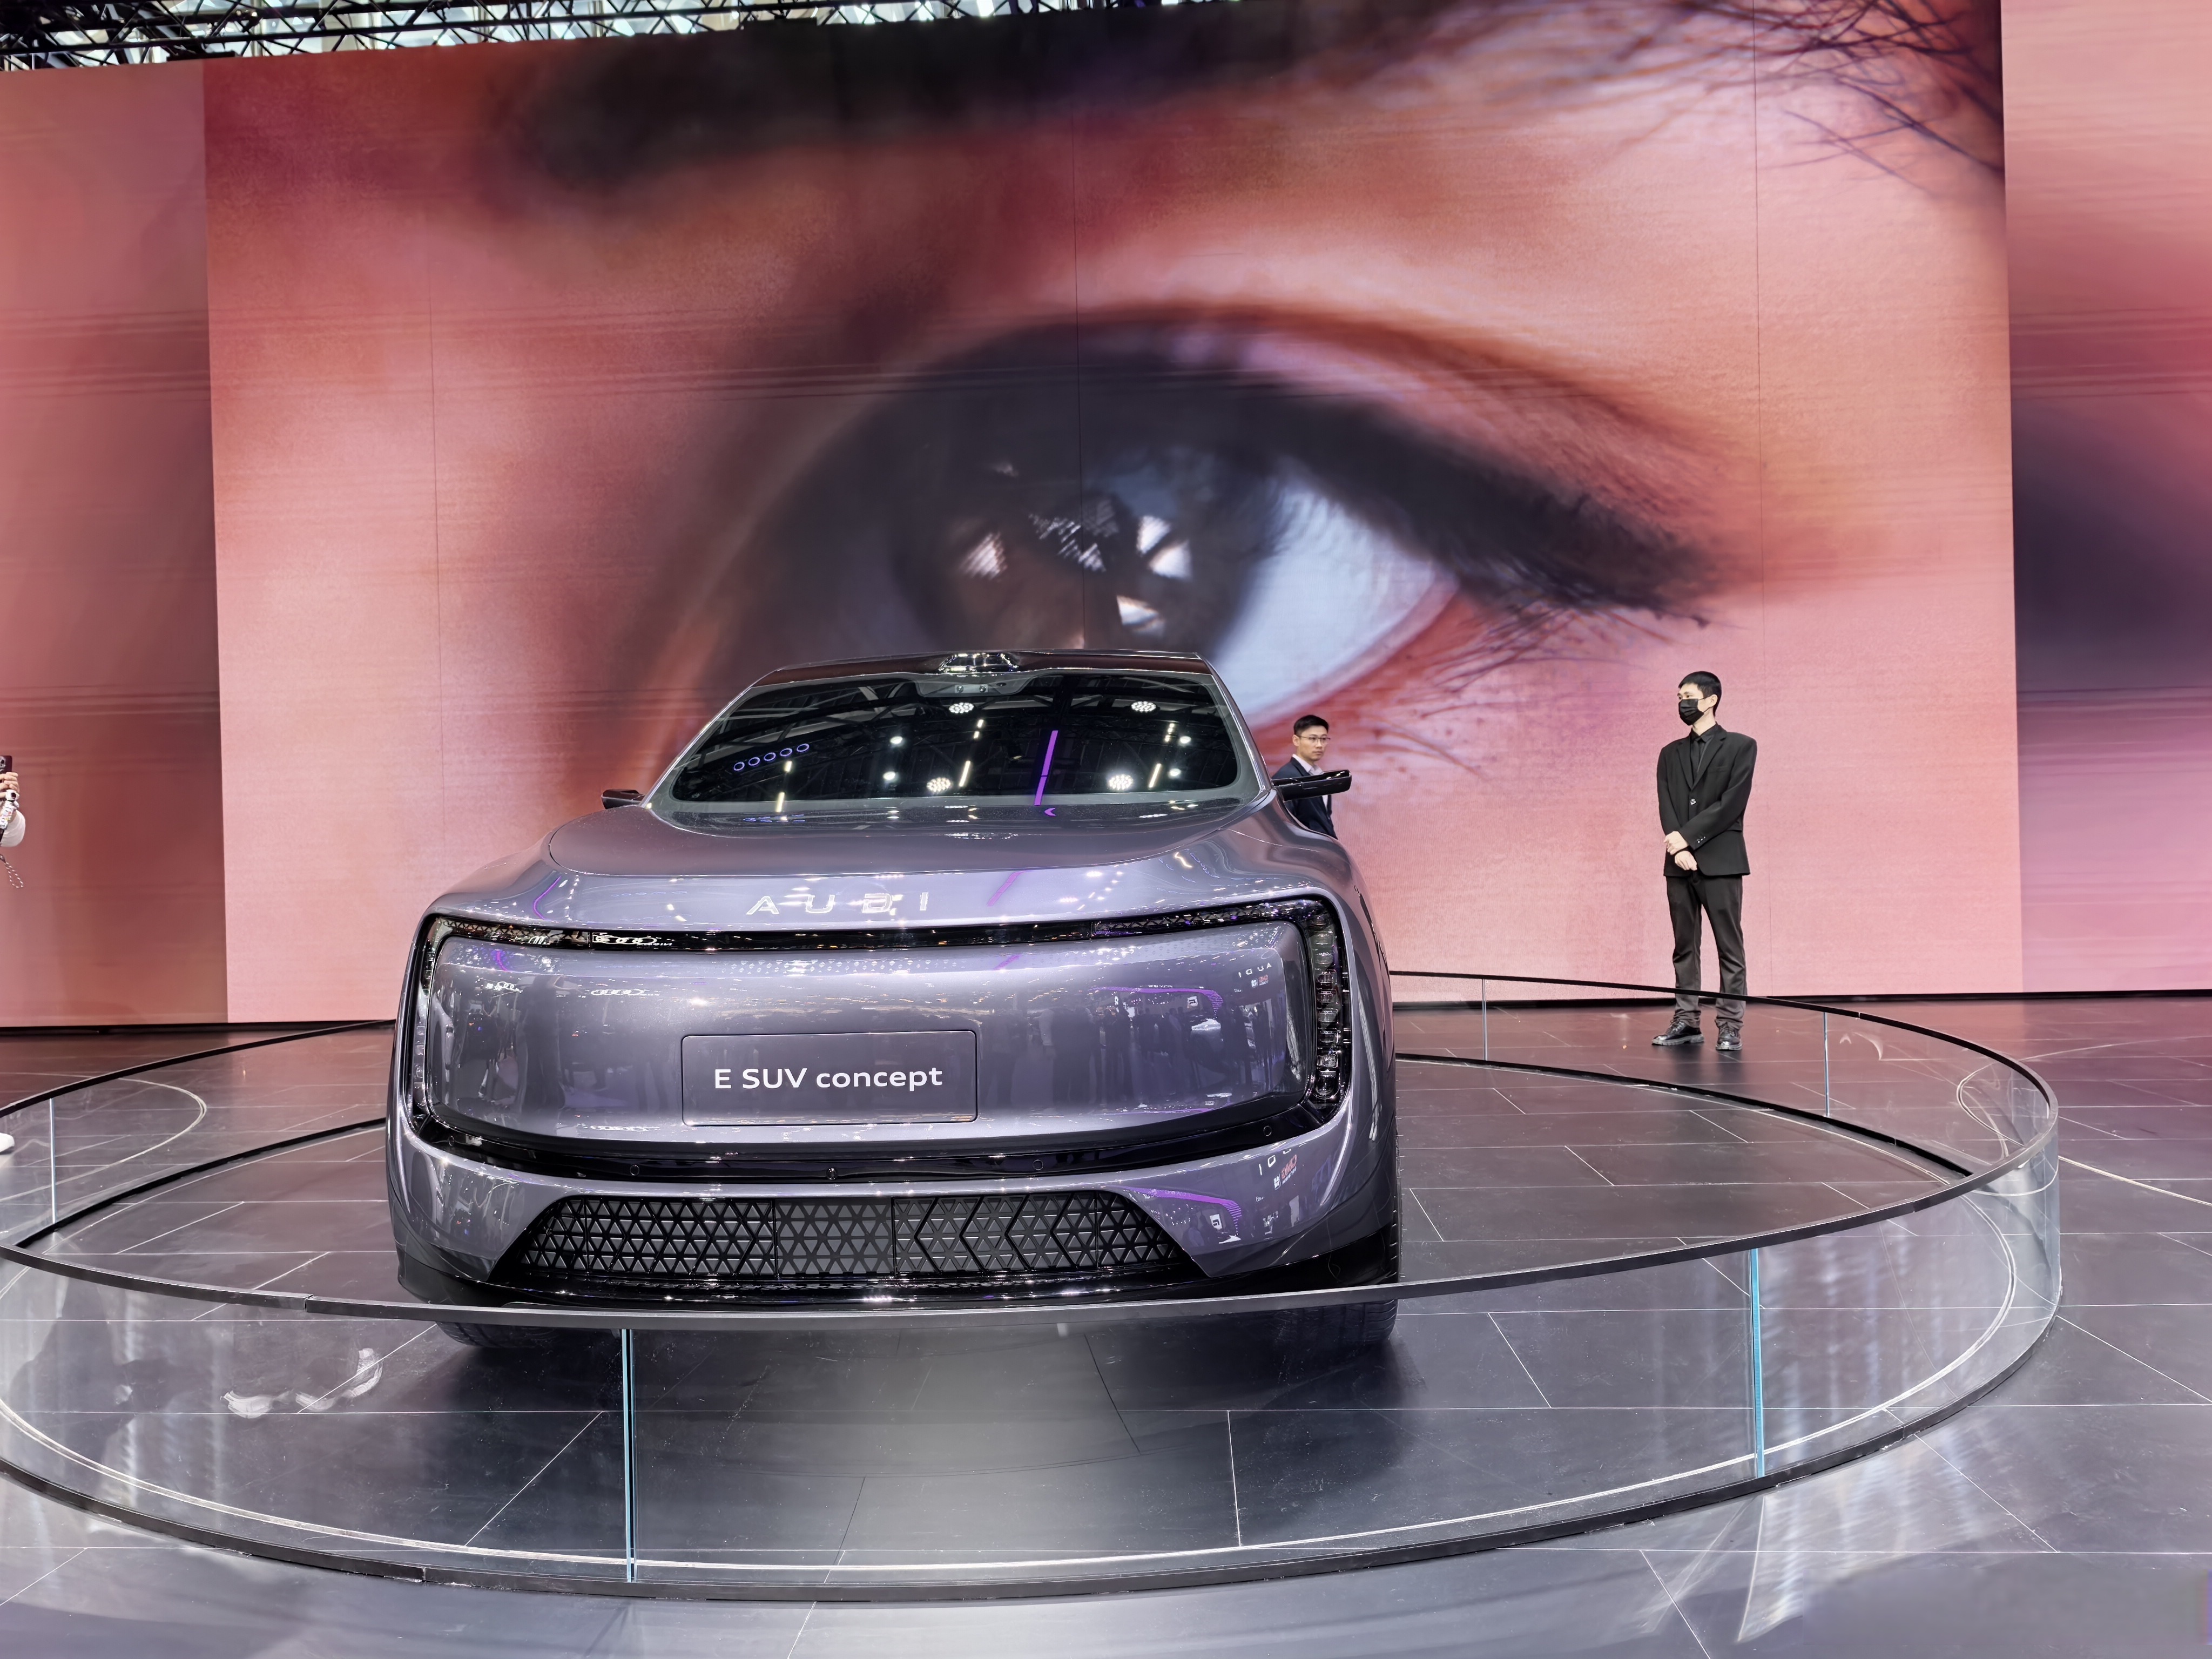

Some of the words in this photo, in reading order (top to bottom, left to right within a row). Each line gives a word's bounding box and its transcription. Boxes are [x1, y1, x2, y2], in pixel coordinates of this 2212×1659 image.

[745, 892, 929, 915] AUDI
[714, 1068, 732, 1089] E
[742, 1068, 807, 1089] SUV
[816, 1067, 942, 1091] concept
